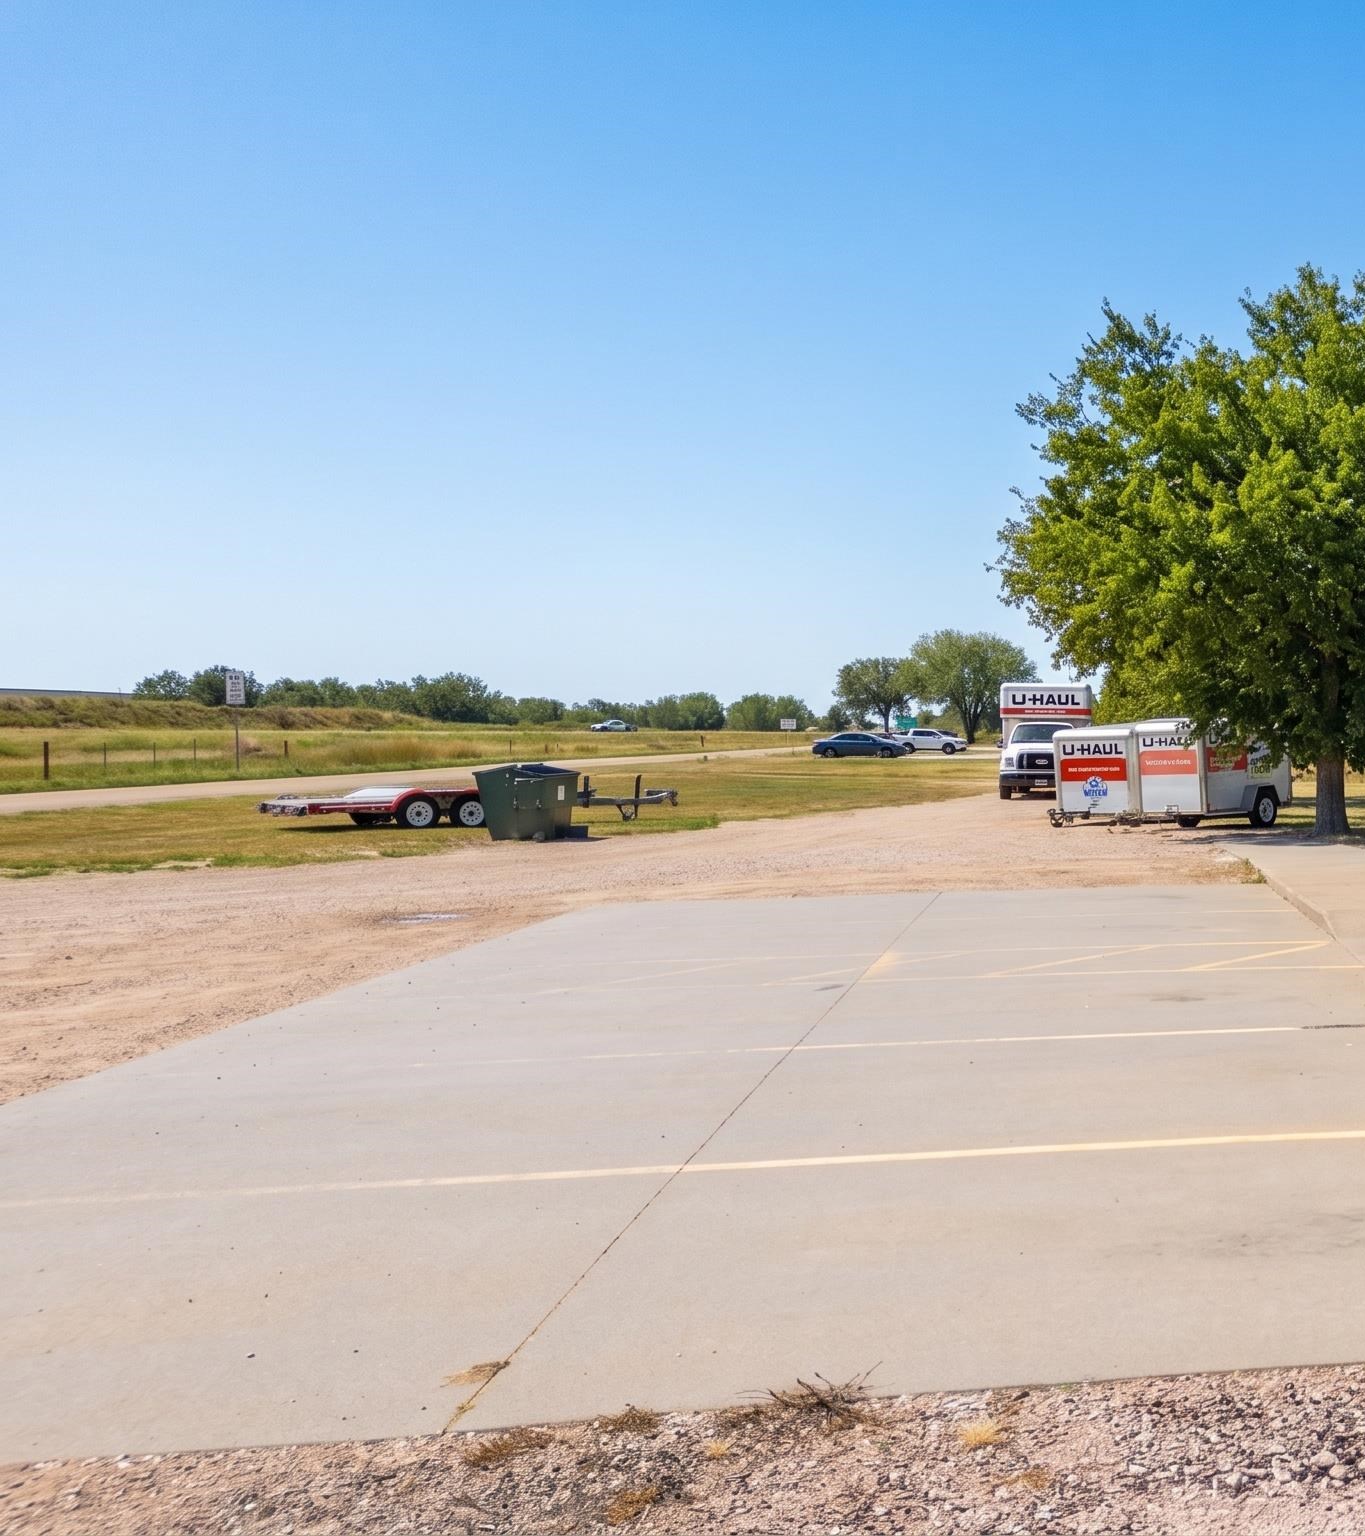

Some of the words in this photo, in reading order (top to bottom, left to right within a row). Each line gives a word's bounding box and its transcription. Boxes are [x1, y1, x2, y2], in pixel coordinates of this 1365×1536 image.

[1011, 693, 1081, 706] U-HAUL
[1142, 736, 1196, 748] U-HA
[1062, 743, 1123, 756] U-HAUL
